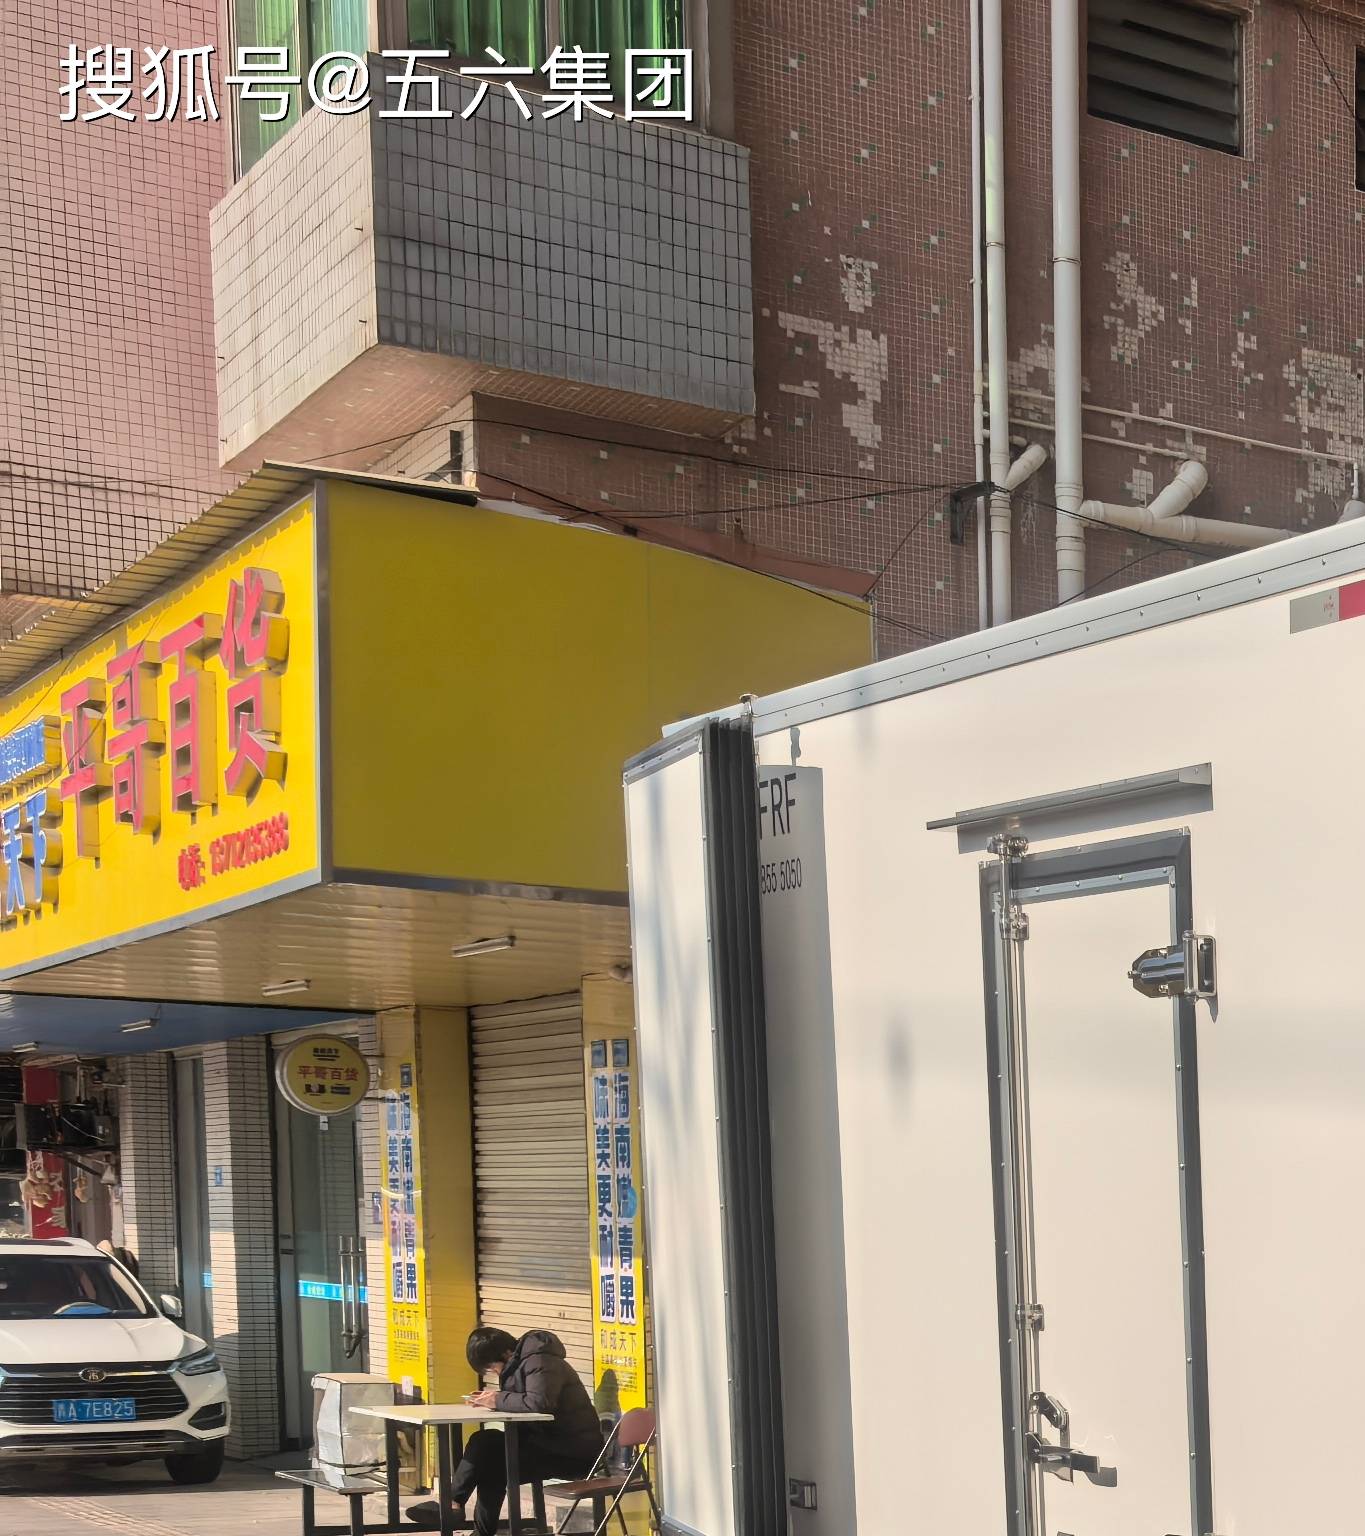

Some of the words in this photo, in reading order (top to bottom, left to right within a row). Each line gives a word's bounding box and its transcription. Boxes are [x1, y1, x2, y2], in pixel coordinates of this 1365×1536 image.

[60, 566, 272, 858] 平哥百货
[780, 858, 802, 891] 5050
